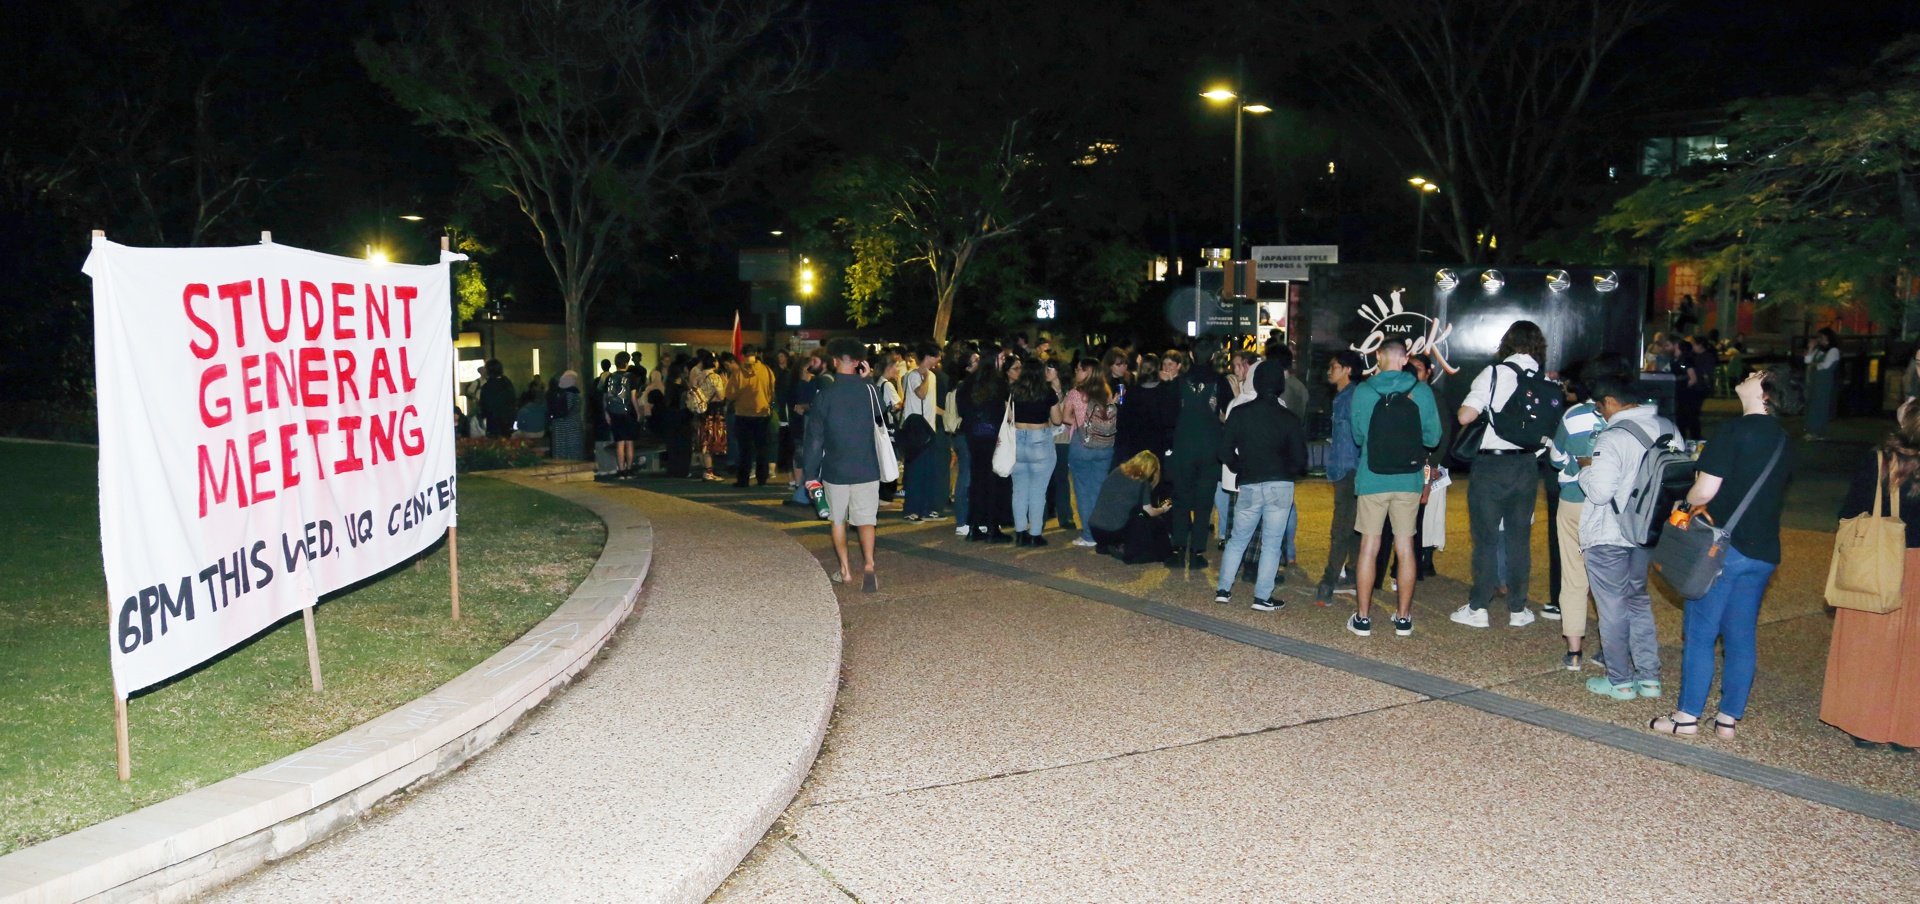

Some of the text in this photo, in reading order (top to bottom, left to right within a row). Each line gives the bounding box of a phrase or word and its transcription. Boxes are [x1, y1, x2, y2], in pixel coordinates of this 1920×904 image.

[183, 278, 418, 360] STUDENT
[1385, 324, 1412, 333] THAT
[198, 346, 418, 428] GENERAL
[198, 405, 426, 518] MEETING
[118, 576, 194, 653] 6PM
[199, 540, 273, 612] THIS
[282, 520, 341, 573] WED,
[388, 475, 456, 537] CENTER
[263, 696, 469, 775] THIS WAY
